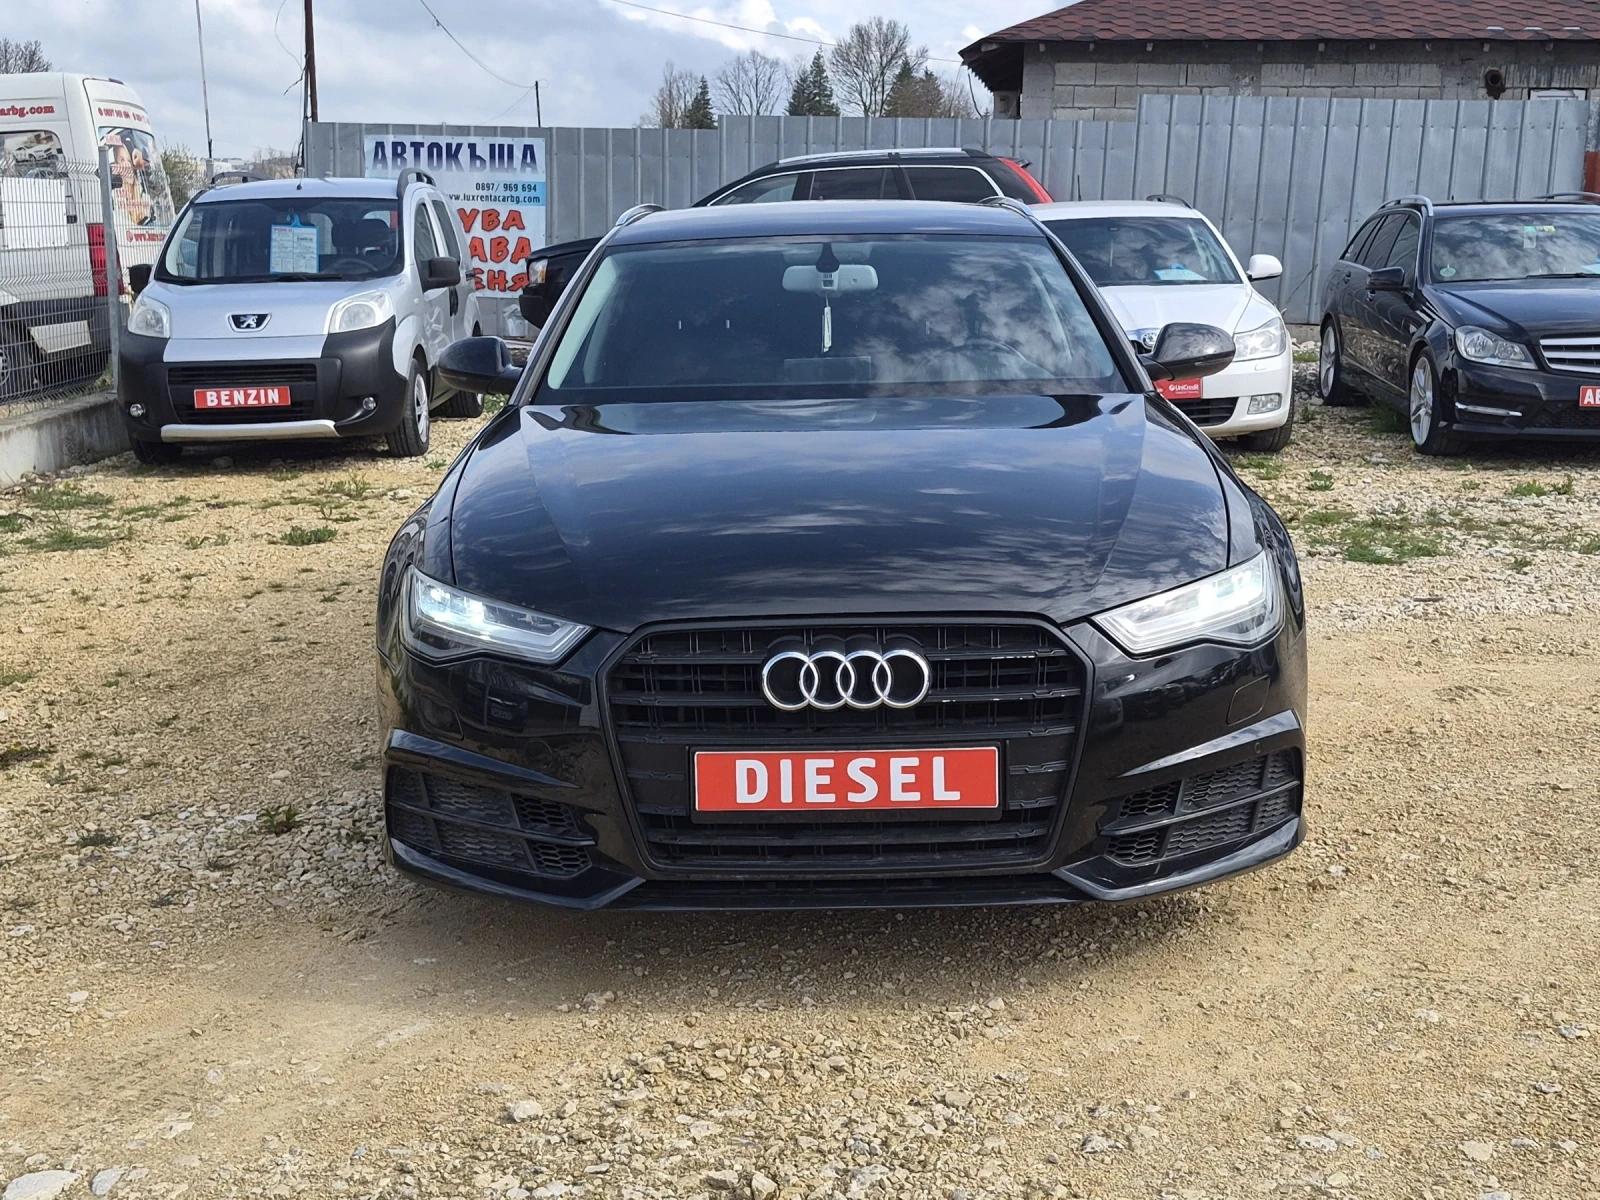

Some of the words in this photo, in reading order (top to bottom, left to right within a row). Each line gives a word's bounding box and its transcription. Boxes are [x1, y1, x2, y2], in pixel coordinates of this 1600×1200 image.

[371, 141, 538, 173] АВТОКЪЩА
[475, 182, 500, 192] 0897/
[503, 183, 518, 192] 969
[521, 184, 537, 193] 694
[206, 388, 280, 407] BENZIN
[735, 756, 961, 803] DIESEL
